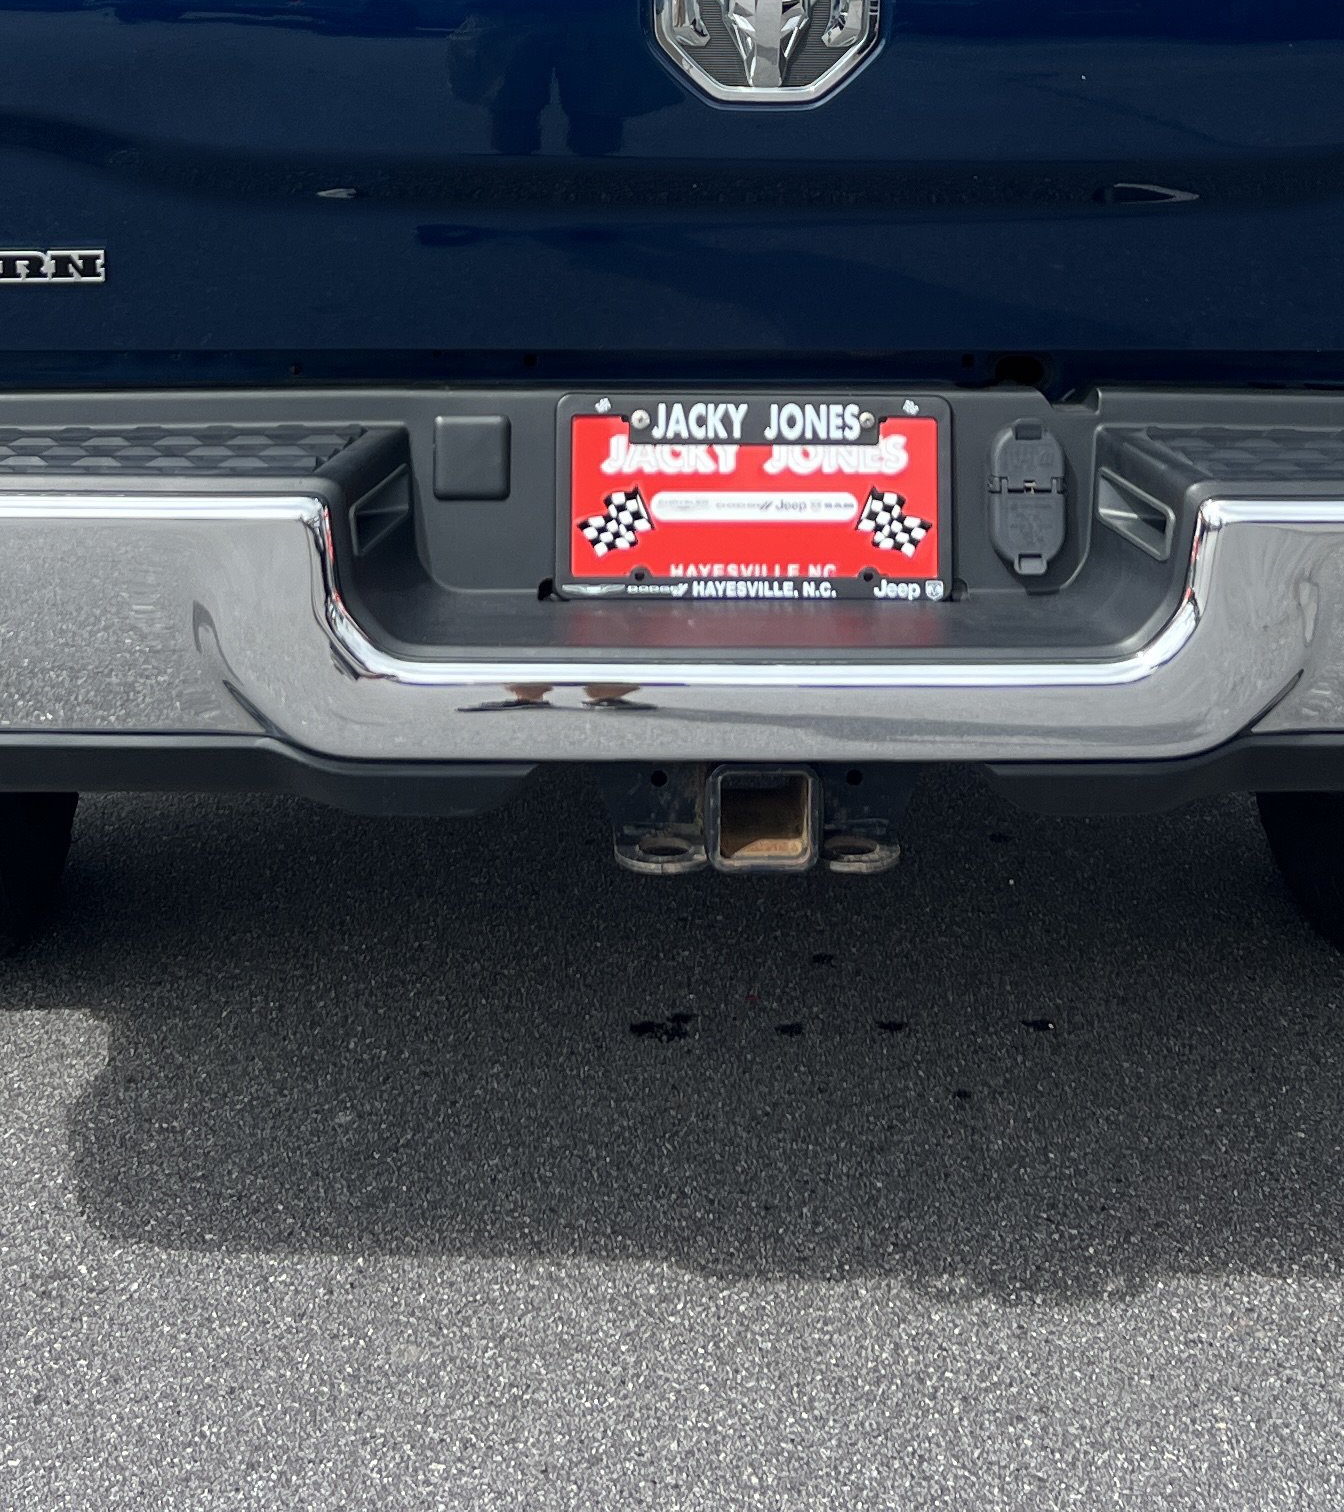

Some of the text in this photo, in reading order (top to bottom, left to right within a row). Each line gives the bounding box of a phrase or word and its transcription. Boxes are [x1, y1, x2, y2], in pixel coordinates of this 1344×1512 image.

[652, 402, 861, 441] JACKY JONES
[601, 434, 909, 476] JACKY JONES
[692, 580, 799, 599] HAYESVILLE,
[802, 580, 837, 599] N.C.
[873, 578, 921, 601] Jeep
